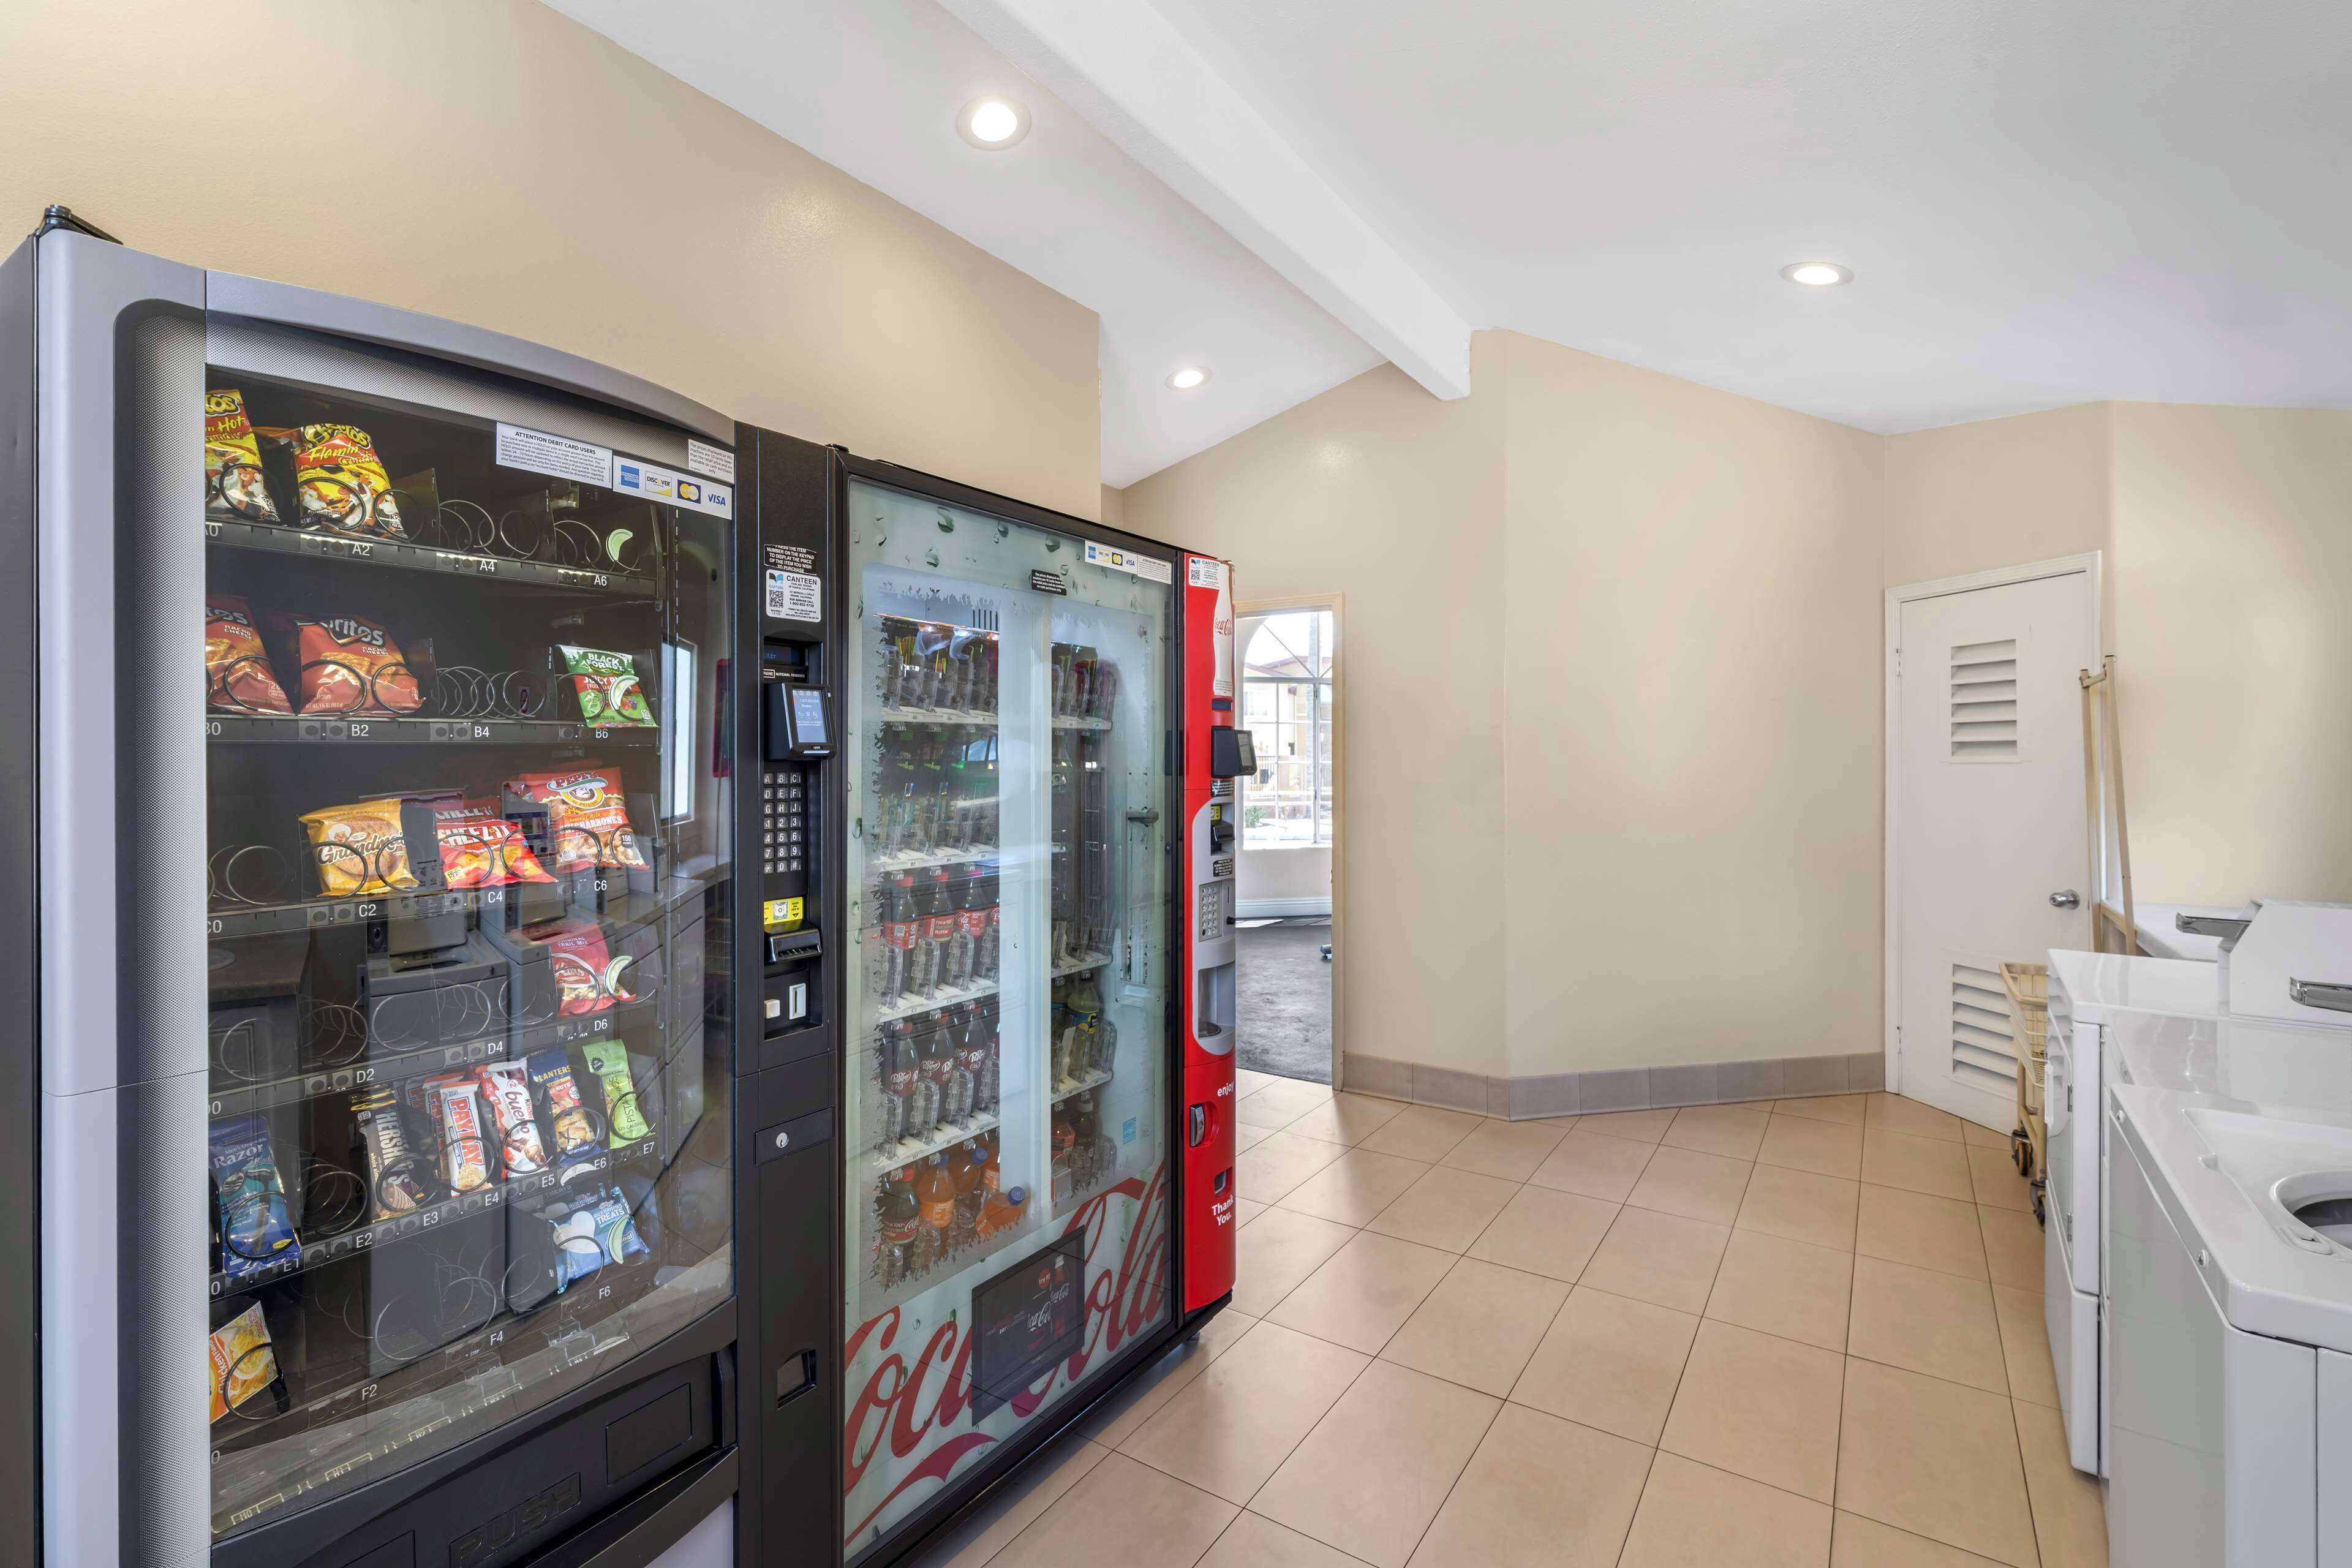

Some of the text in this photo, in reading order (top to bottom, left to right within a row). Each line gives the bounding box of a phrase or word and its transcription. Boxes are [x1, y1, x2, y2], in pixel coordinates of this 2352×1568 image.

[217, 415, 245, 432] Hot
[515, 431, 547, 442] ATTENTION
[708, 494, 726, 506] VISA
[352, 544, 370, 556] A2
[480, 560, 495, 572] A4
[594, 575, 608, 586] A6
[786, 576, 817, 585] CANTEEN
[224, 625, 251, 636] NACHO
[224, 628, 252, 641] CHEESE
[330, 617, 385, 646] ritos
[587, 660, 624, 671] FOREST
[588, 653, 619, 666] BLACK
[352, 725, 369, 736] B2
[474, 726, 490, 737] B4
[595, 728, 609, 739] B6
[553, 772, 598, 788] PEPE'S
[766, 790, 770, 799] D
[779, 790, 783, 798] E
[586, 811, 601, 820] Chile
[766, 805, 771, 813] G
[793, 818, 796, 826] 3
[766, 834, 771, 843] 4
[793, 846, 797, 855] 9
[780, 862, 784, 871] 0
[594, 880, 607, 892] C6
[488, 891, 503, 903] C4
[359, 904, 377, 918] C2
[594, 1019, 608, 1031] D6
[488, 1041, 503, 1055] D4
[356, 1068, 375, 1083] D2
[533, 1065, 571, 1083] PLANTERS
[1218, 1082, 1235, 1097] enjoy
[448, 1096, 484, 1166] PAYDAY
[643, 1142, 655, 1155] E7
[214, 1144, 264, 1169] Razor
[594, 1160, 606, 1171] E6
[541, 1176, 554, 1188] E5
[485, 1194, 499, 1207] E4
[1212, 1194, 1234, 1216] Thank
[594, 1204, 623, 1219] RICE KRISPIES
[596, 1208, 625, 1225] TREATS
[424, 1212, 439, 1226] E3
[1216, 1213, 1232, 1226] You.
[356, 1232, 372, 1248] E2
[599, 1286, 611, 1299] F6
[491, 1332, 503, 1346] F4
[363, 1384, 377, 1400] F2
[458, 1479, 579, 1568] PUSH
